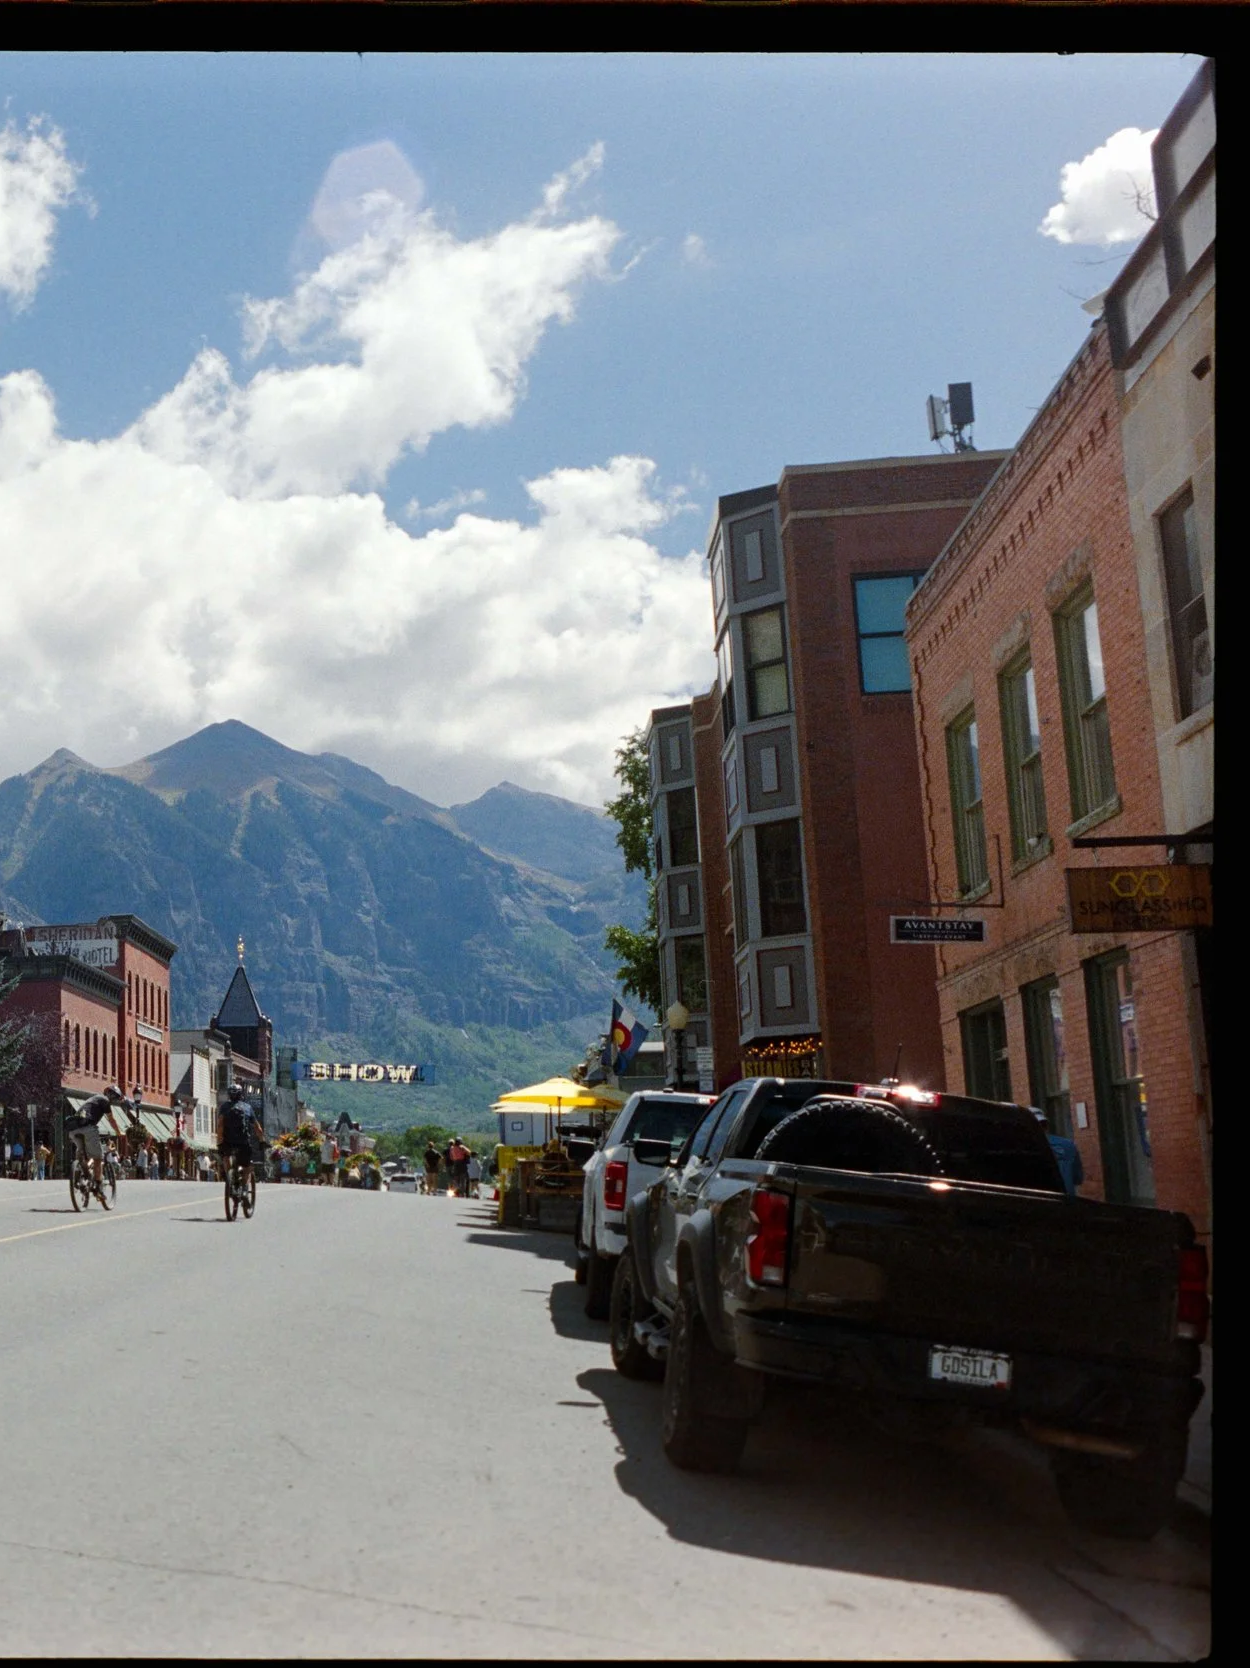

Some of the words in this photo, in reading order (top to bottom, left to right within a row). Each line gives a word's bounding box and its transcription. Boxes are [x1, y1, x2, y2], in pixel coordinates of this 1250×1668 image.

[1079, 899, 1170, 915] SUNGLASS
[904, 921, 974, 930] AVANTSTAY
[37, 926, 115, 941] SHERIDAN
[309, 1062, 416, 1083] SHOW
